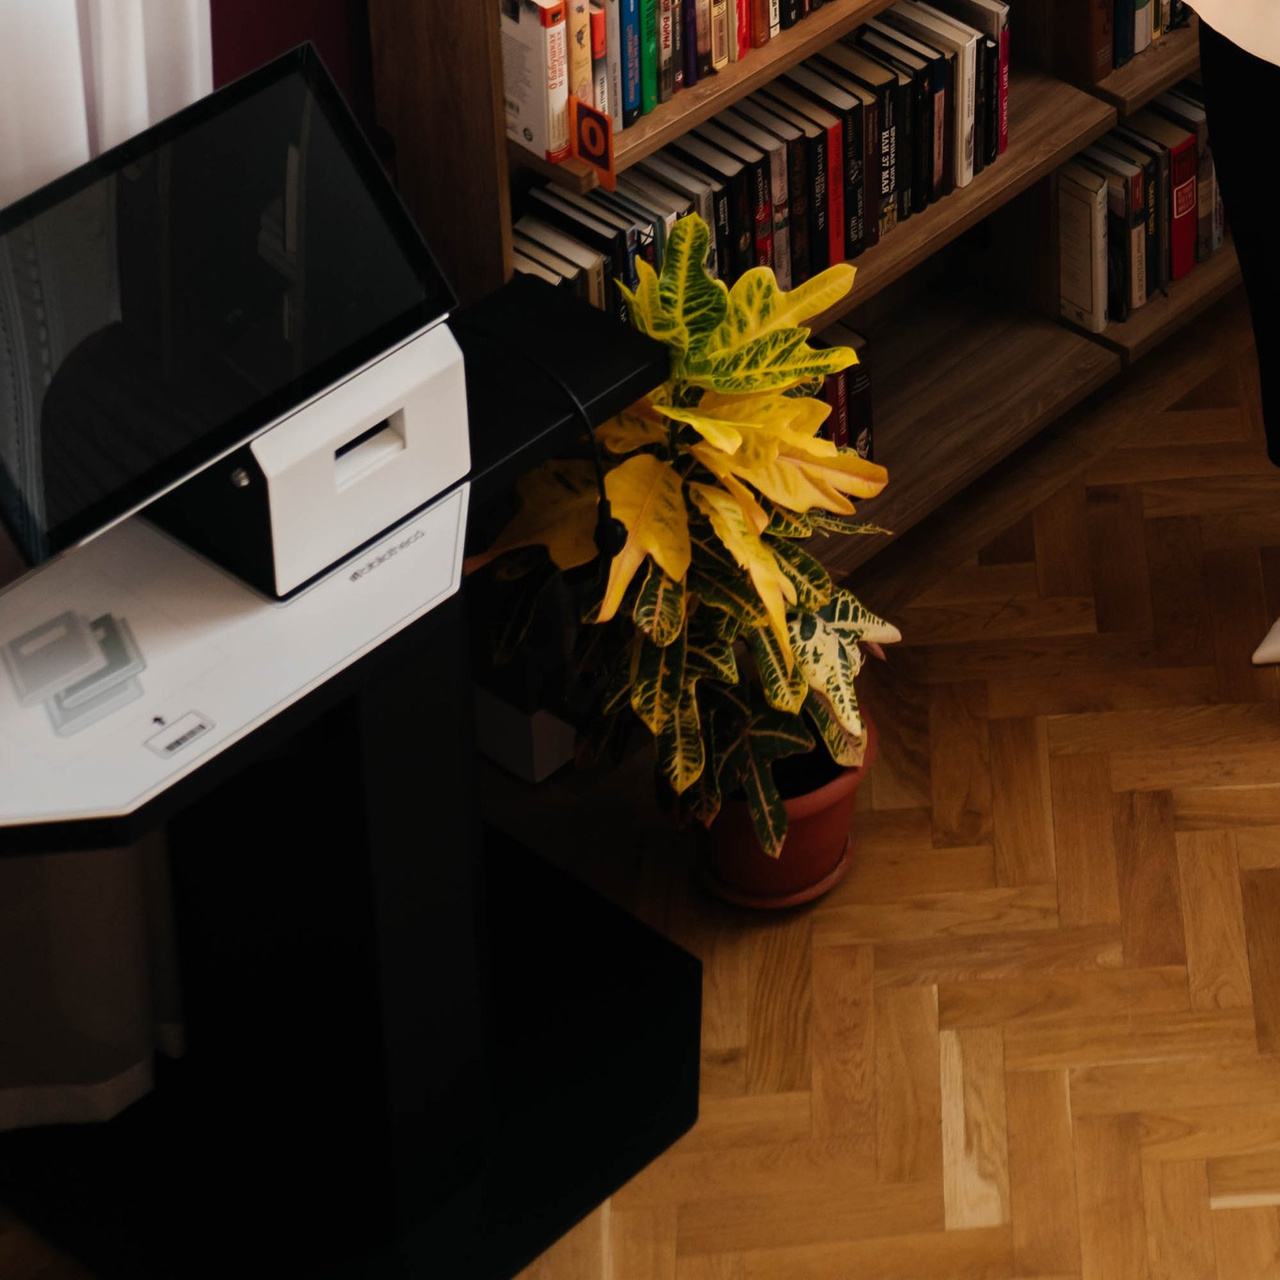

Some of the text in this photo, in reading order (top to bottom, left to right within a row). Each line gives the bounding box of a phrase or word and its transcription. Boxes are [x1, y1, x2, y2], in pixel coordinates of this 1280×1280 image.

[662, 16, 670, 49] ВОЙНА
[548, 33, 558, 80] бабушках
[880, 155, 888, 167] 37
[880, 170, 889, 193] МАЯ
